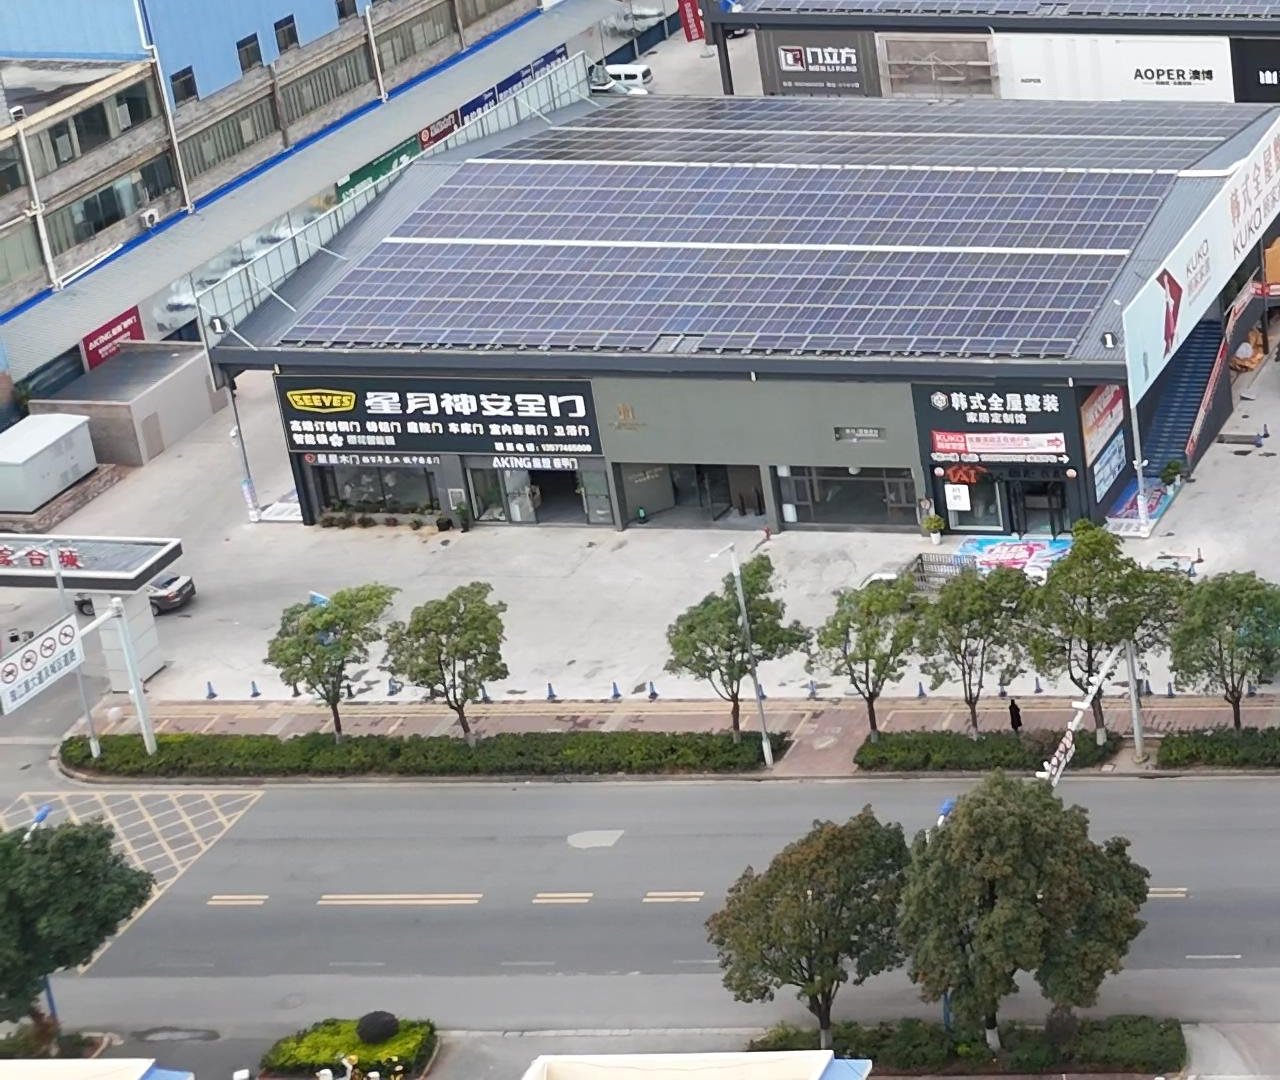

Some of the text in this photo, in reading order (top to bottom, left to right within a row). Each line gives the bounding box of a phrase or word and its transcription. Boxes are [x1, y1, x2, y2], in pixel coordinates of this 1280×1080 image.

[806, 47, 857, 65] 门立方
[1133, 69, 1214, 81] AOPER 澳博
[213, 317, 224, 334] 1
[1104, 333, 1115, 348] 1
[364, 391, 586, 418] 星月神安全门
[951, 393, 1060, 413] 韩式全屋整装
[448, 423, 484, 435] 车库门
[492, 457, 532, 469] AKING
